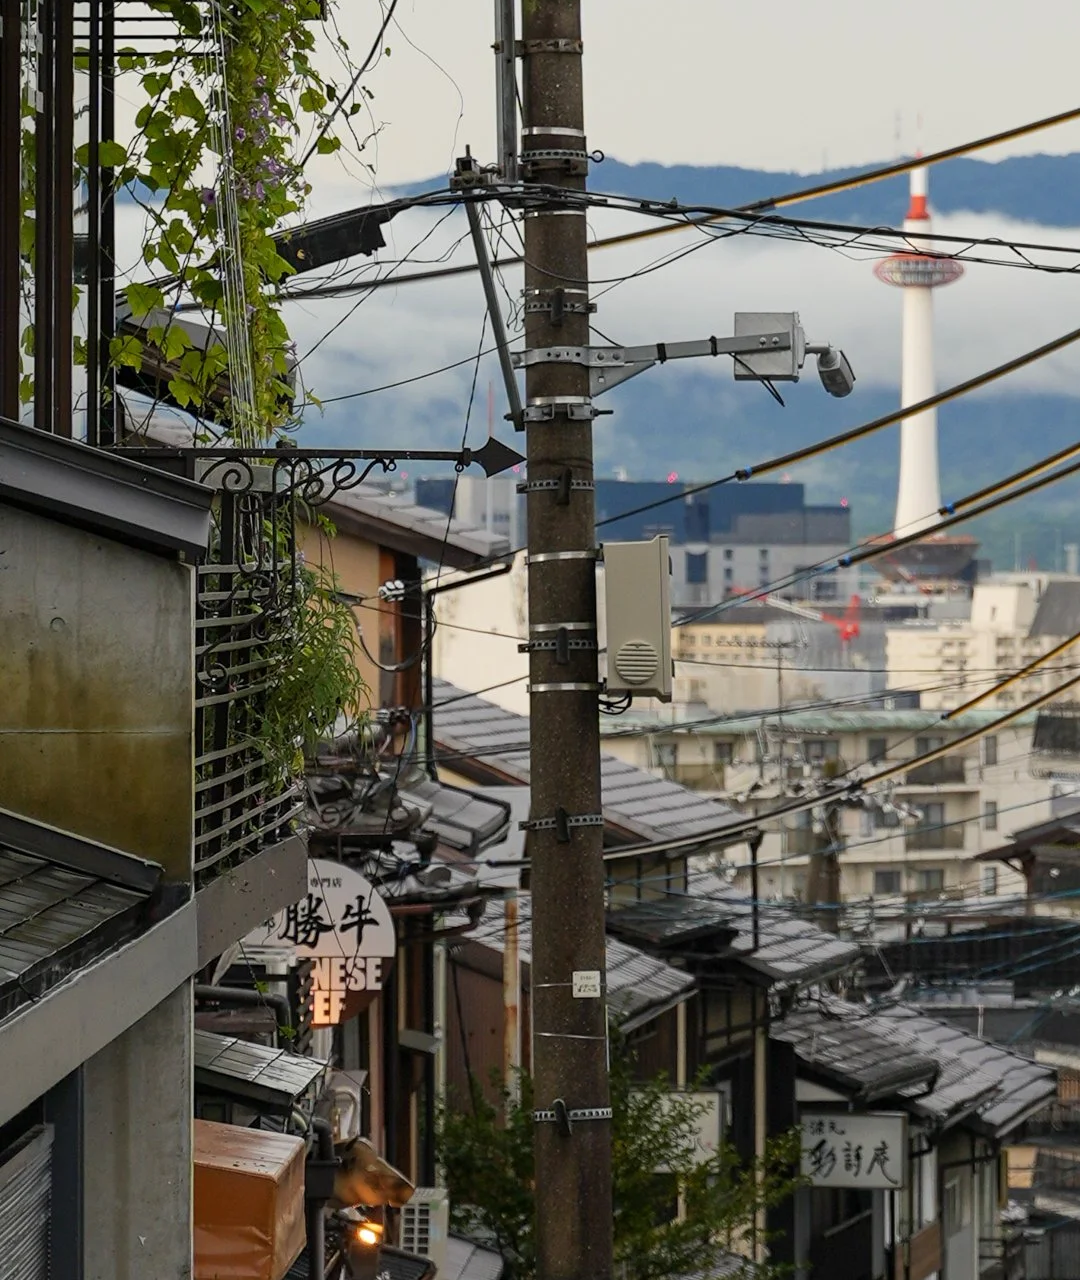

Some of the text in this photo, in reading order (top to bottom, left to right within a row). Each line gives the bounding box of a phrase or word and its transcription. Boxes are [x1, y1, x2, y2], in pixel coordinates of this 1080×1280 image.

[278, 893, 379, 949] 勝牛
[310, 957, 382, 991] NESE
[309, 991, 347, 1024] EF
